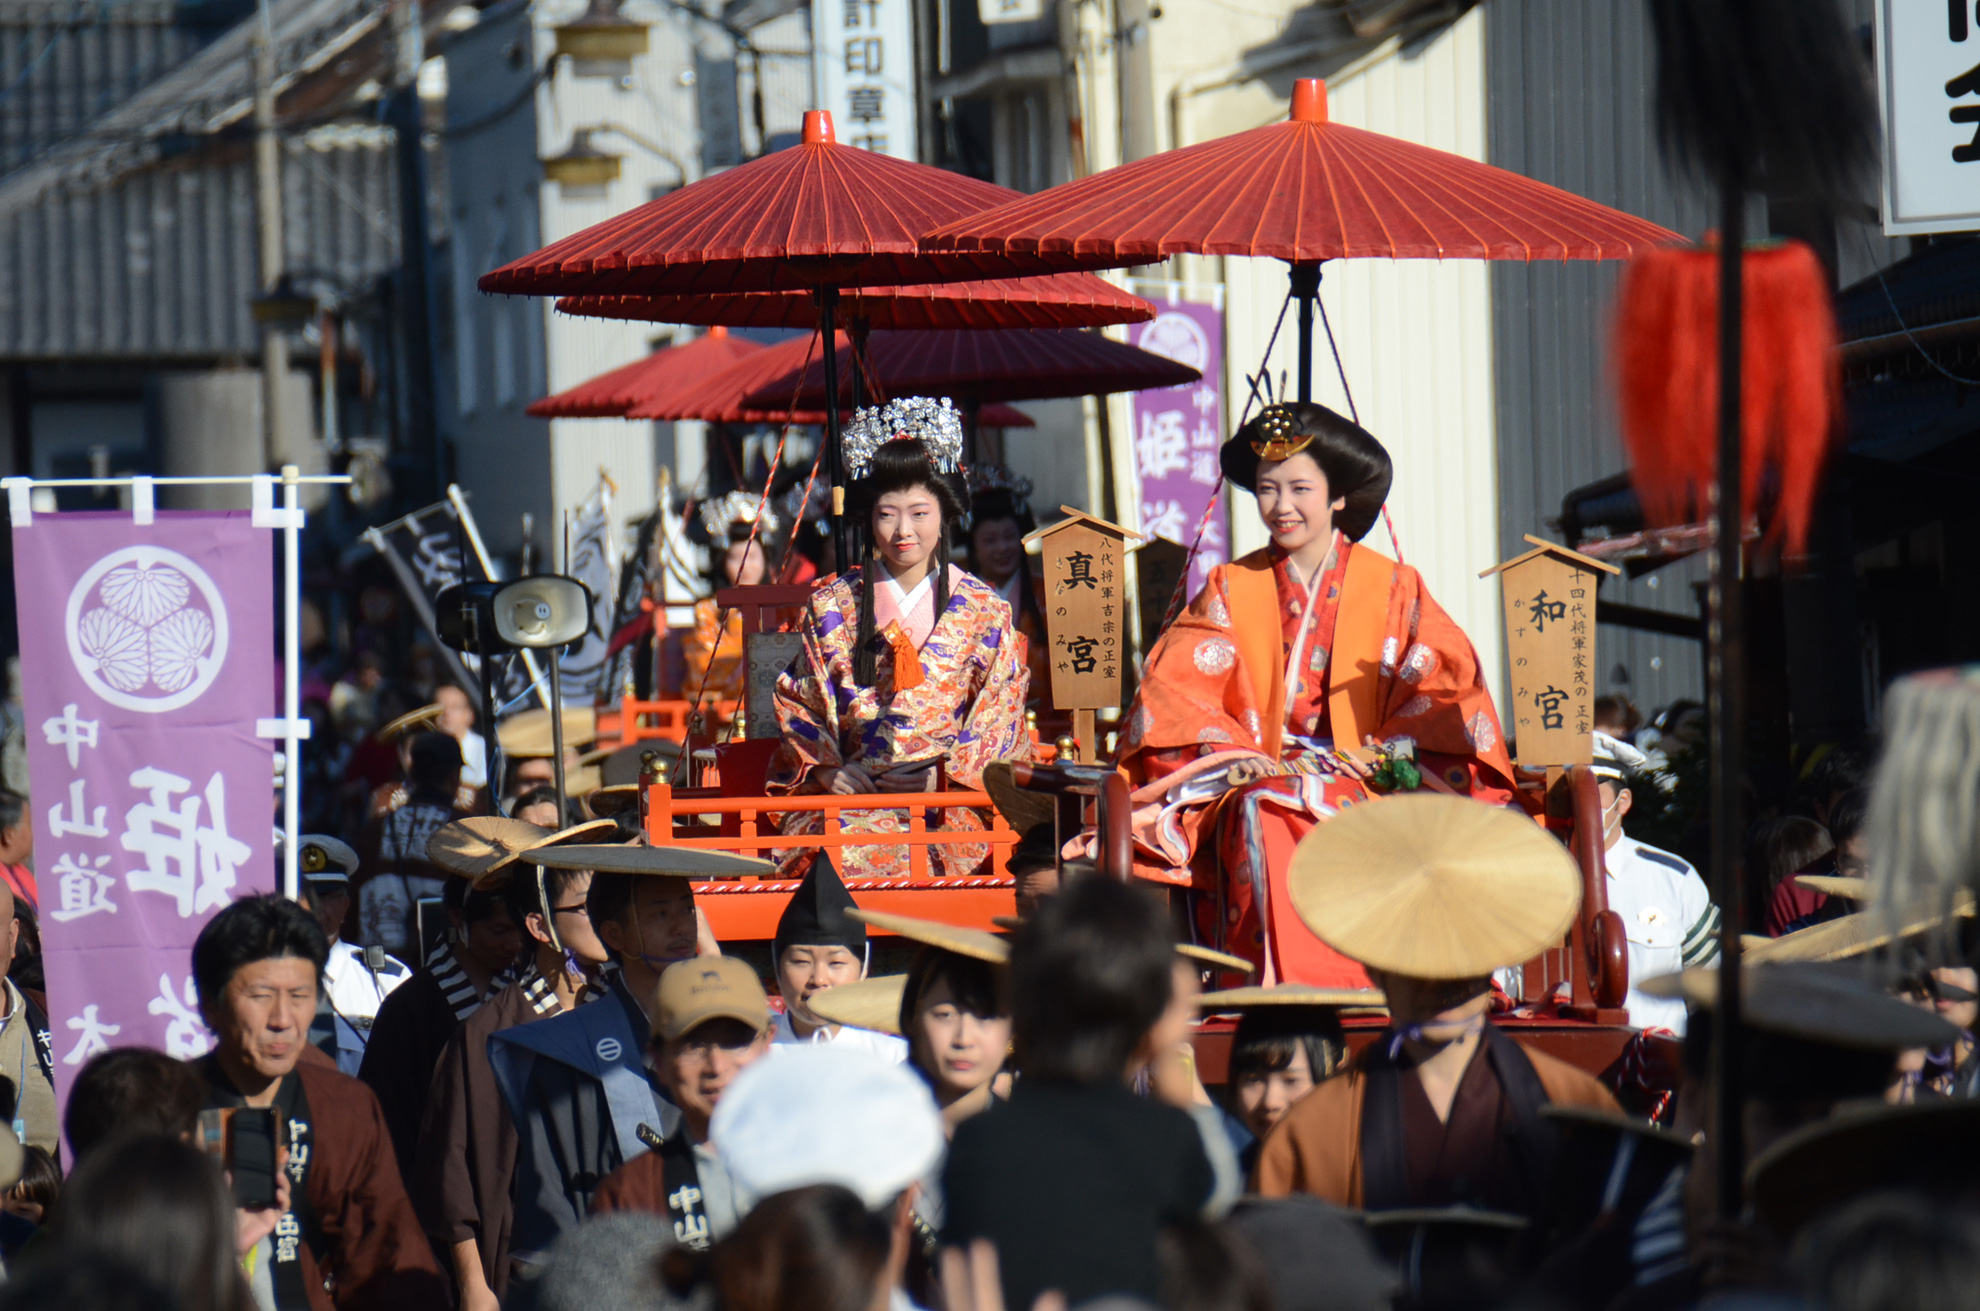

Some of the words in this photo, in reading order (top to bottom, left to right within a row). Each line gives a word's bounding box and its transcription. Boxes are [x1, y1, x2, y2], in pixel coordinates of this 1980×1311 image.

[1063, 551, 1099, 675] 真宮
[1100, 537, 1117, 679] 八代将軍吉宗の正室
[1514, 598, 1530, 727] かずのみや
[1529, 589, 1569, 731] 和宮
[1569, 569, 1590, 735] 十四代将軍家茂の正室
